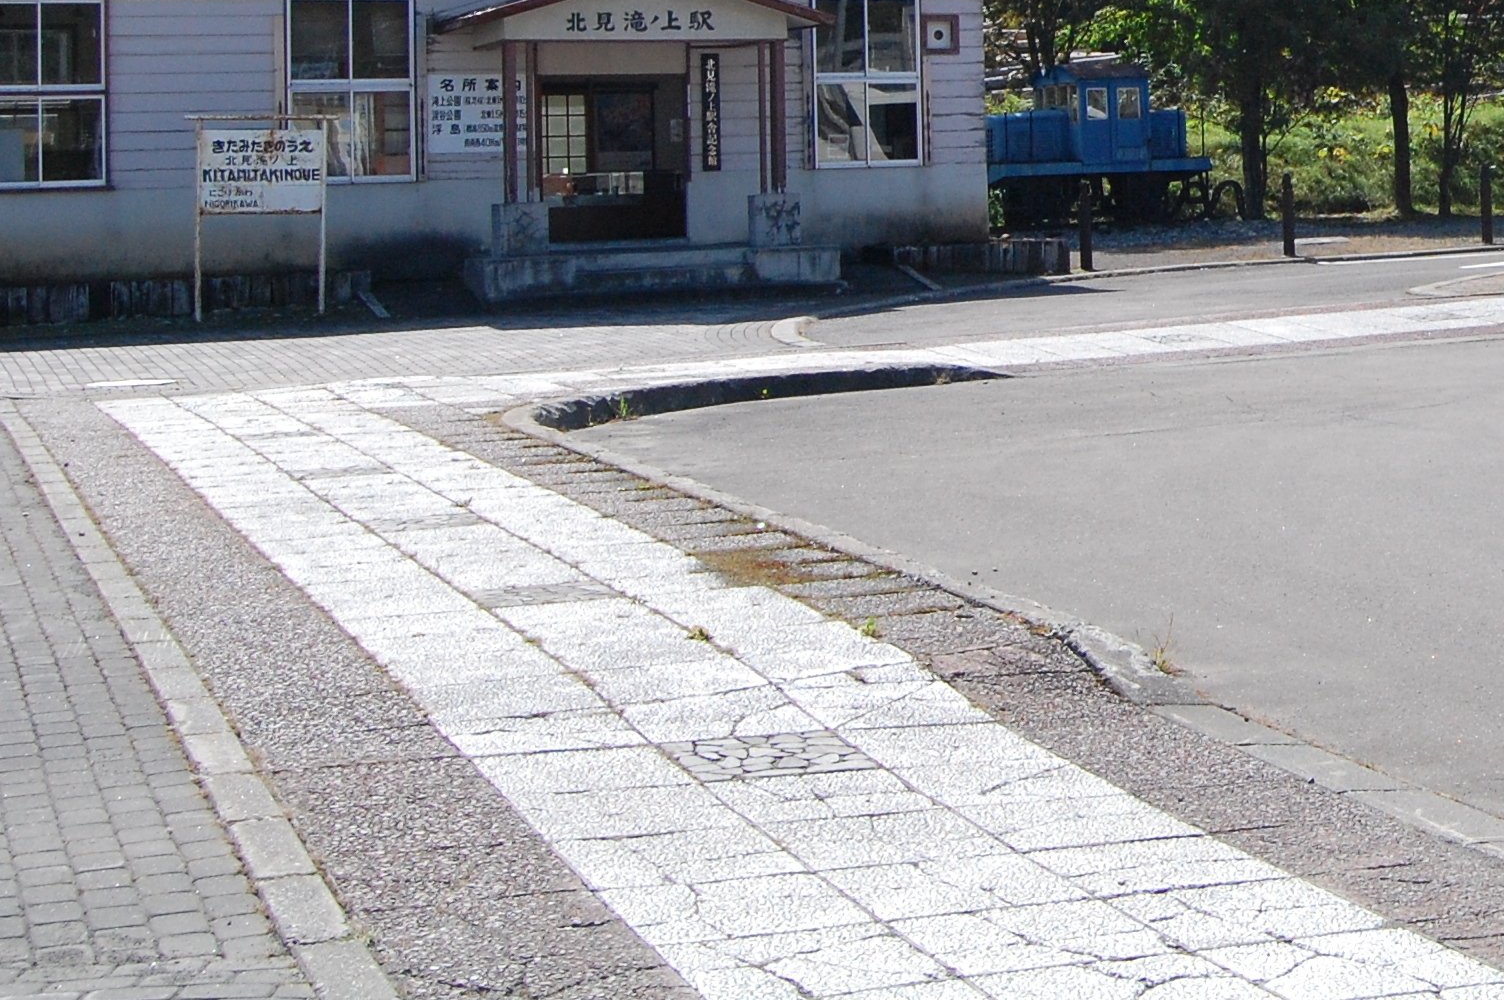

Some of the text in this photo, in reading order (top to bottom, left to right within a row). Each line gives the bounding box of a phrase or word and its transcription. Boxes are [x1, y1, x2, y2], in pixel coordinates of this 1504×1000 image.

[566, 10, 715, 32] 北見滝ノ上駅
[212, 140, 314, 154] きたみたきのうえ
[202, 168, 321, 183] KITAMITAKINOUE
